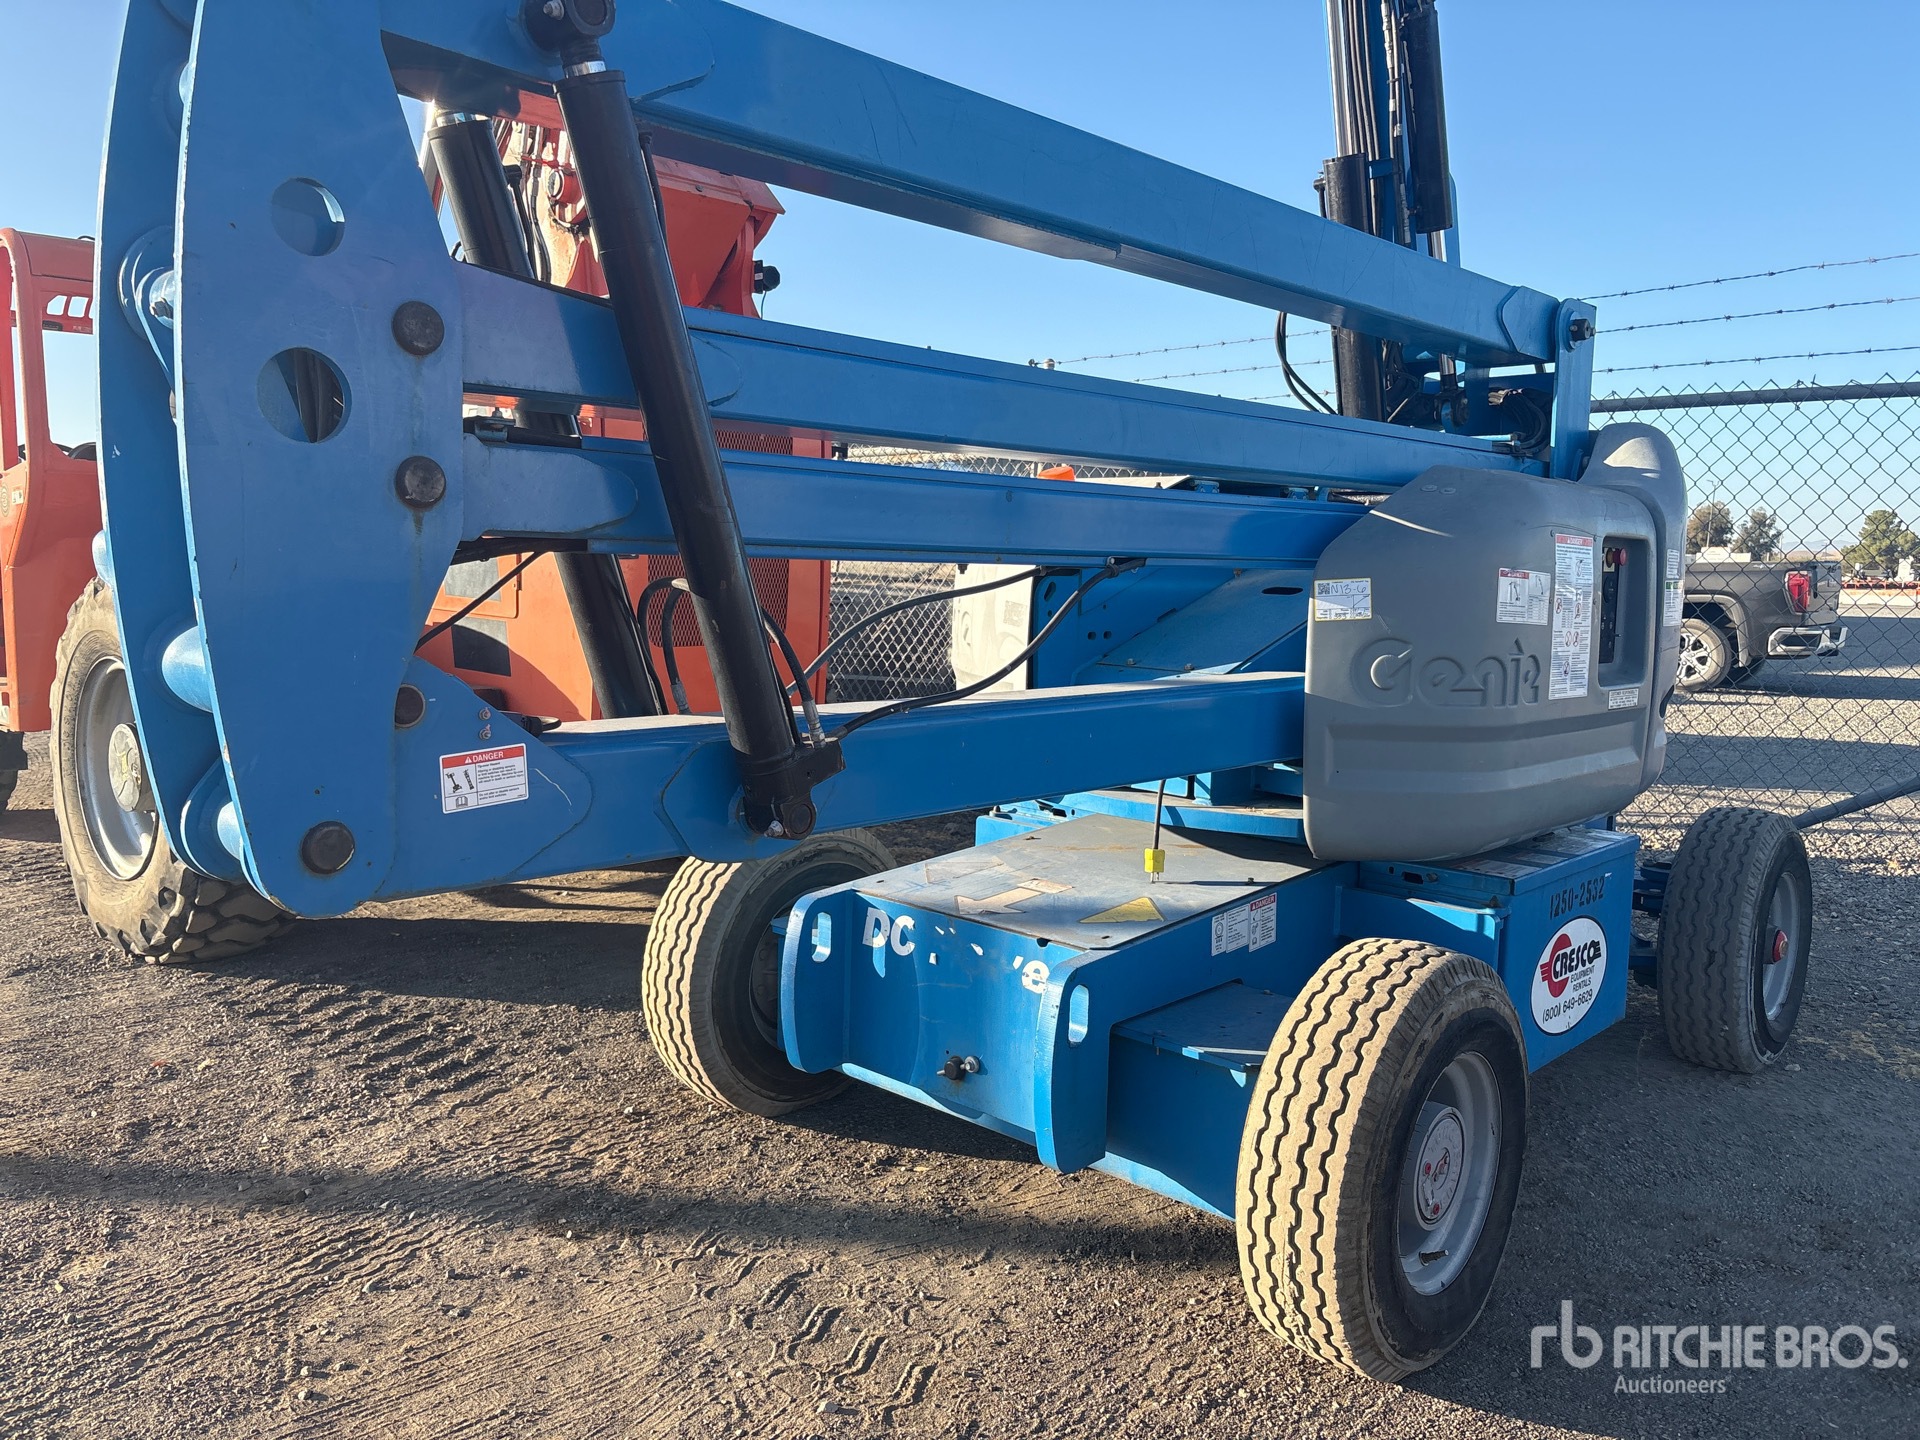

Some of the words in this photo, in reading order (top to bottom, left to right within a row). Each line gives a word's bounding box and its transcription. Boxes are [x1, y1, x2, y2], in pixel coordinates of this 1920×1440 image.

[1331, 584, 1366, 594] N13-6
[472, 751, 504, 763] DANGER
[862, 906, 916, 957] DC
[1553, 939, 1601, 980] CRESCO
[1570, 965, 1595, 983] EQUIPMENT
[1572, 977, 1592, 993] RENTALS
[1543, 1003, 1561, 1024] (800)
[1562, 988, 1593, 1014] 649-6629
